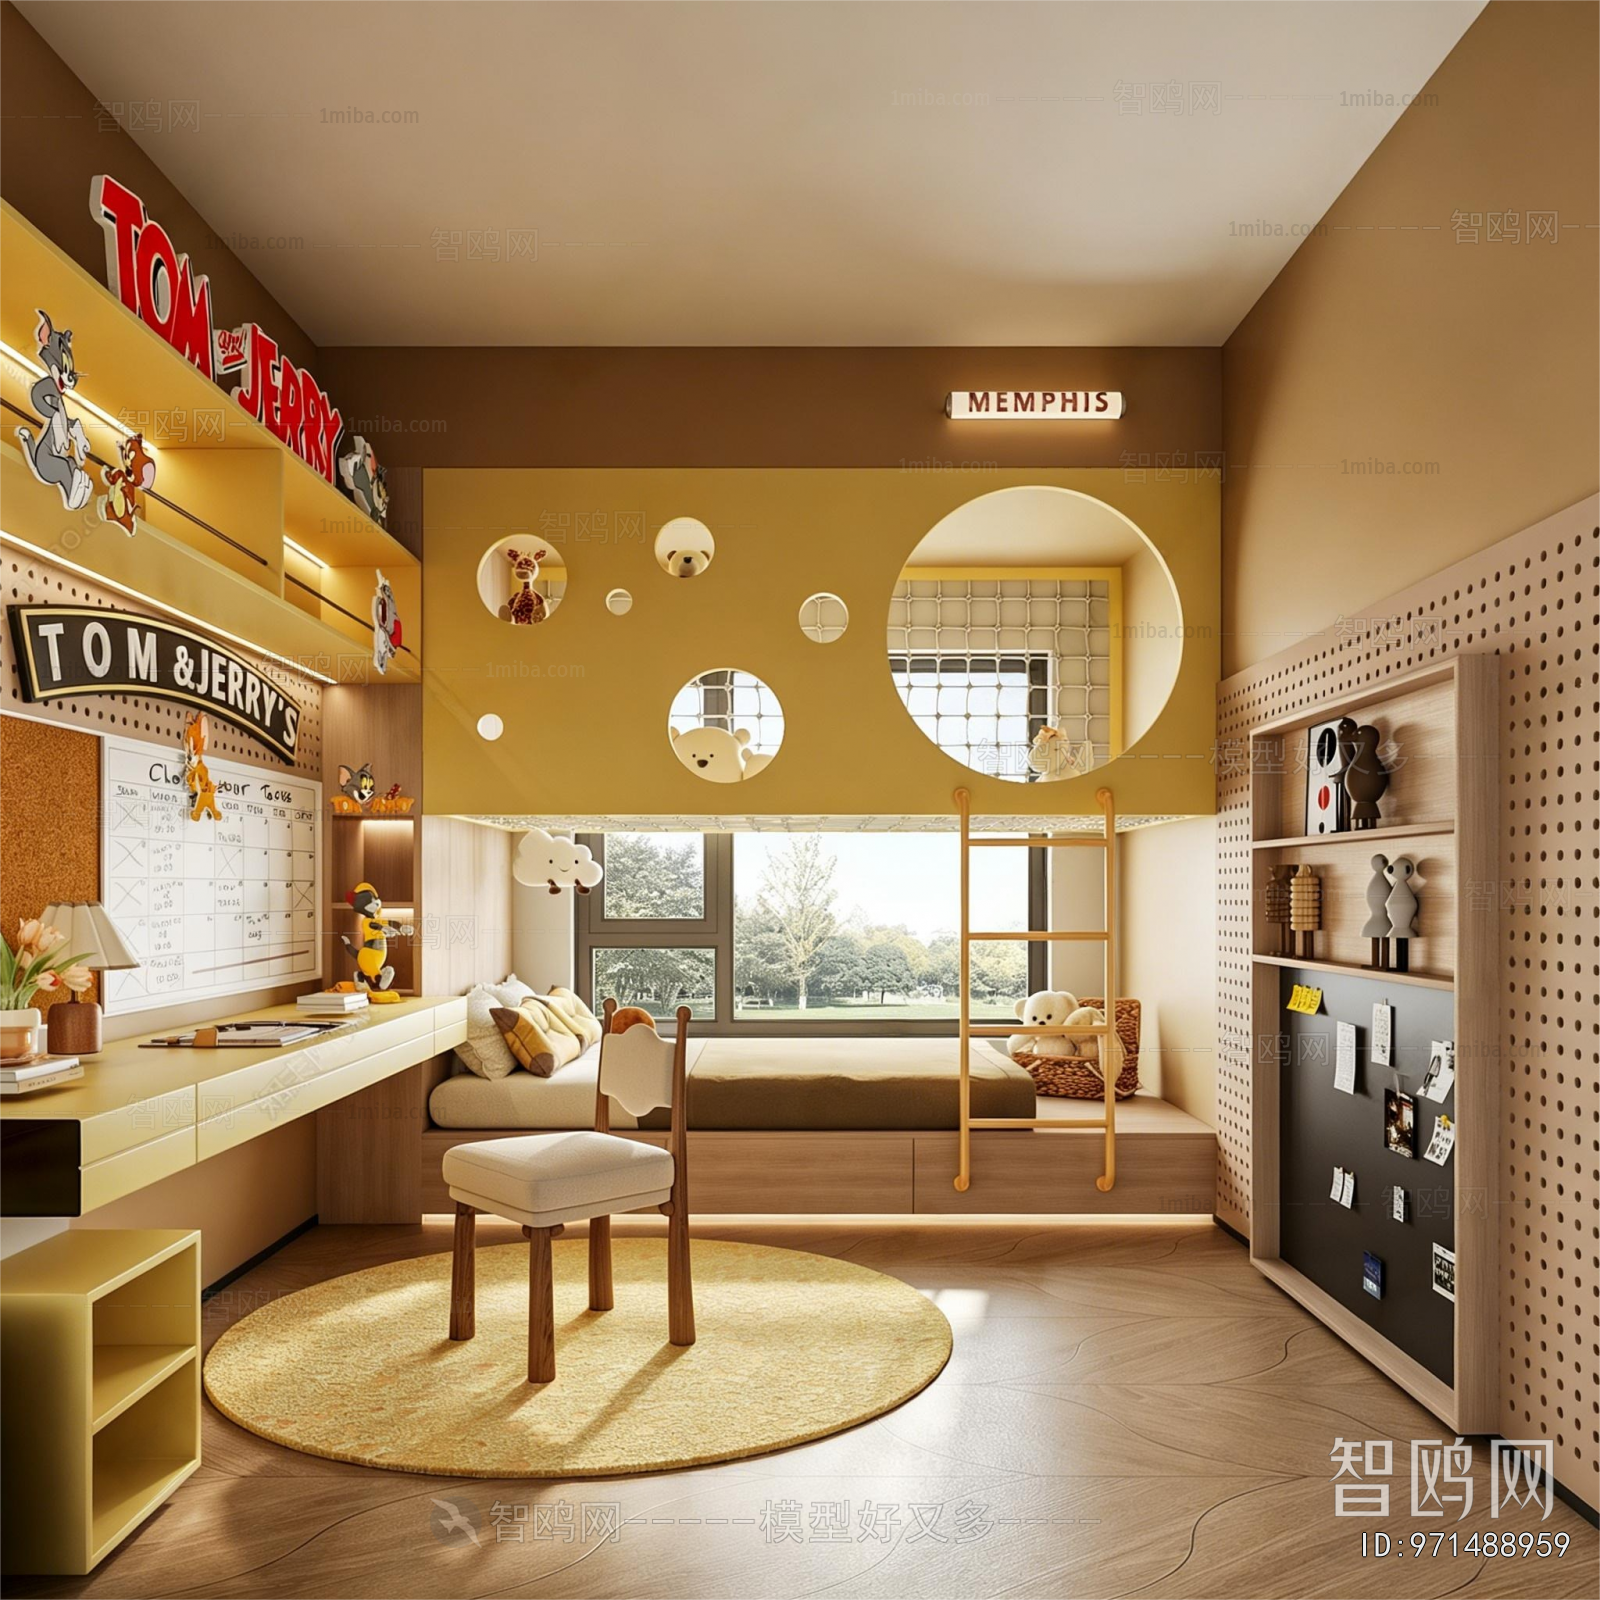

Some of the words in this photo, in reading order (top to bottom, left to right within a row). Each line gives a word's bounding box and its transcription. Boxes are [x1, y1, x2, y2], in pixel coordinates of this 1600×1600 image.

[92, 174, 217, 383] TOM
[232, 323, 343, 486] JERRY
[968, 391, 1110, 414] MEMPHIS
[38, 621, 158, 683] TOM
